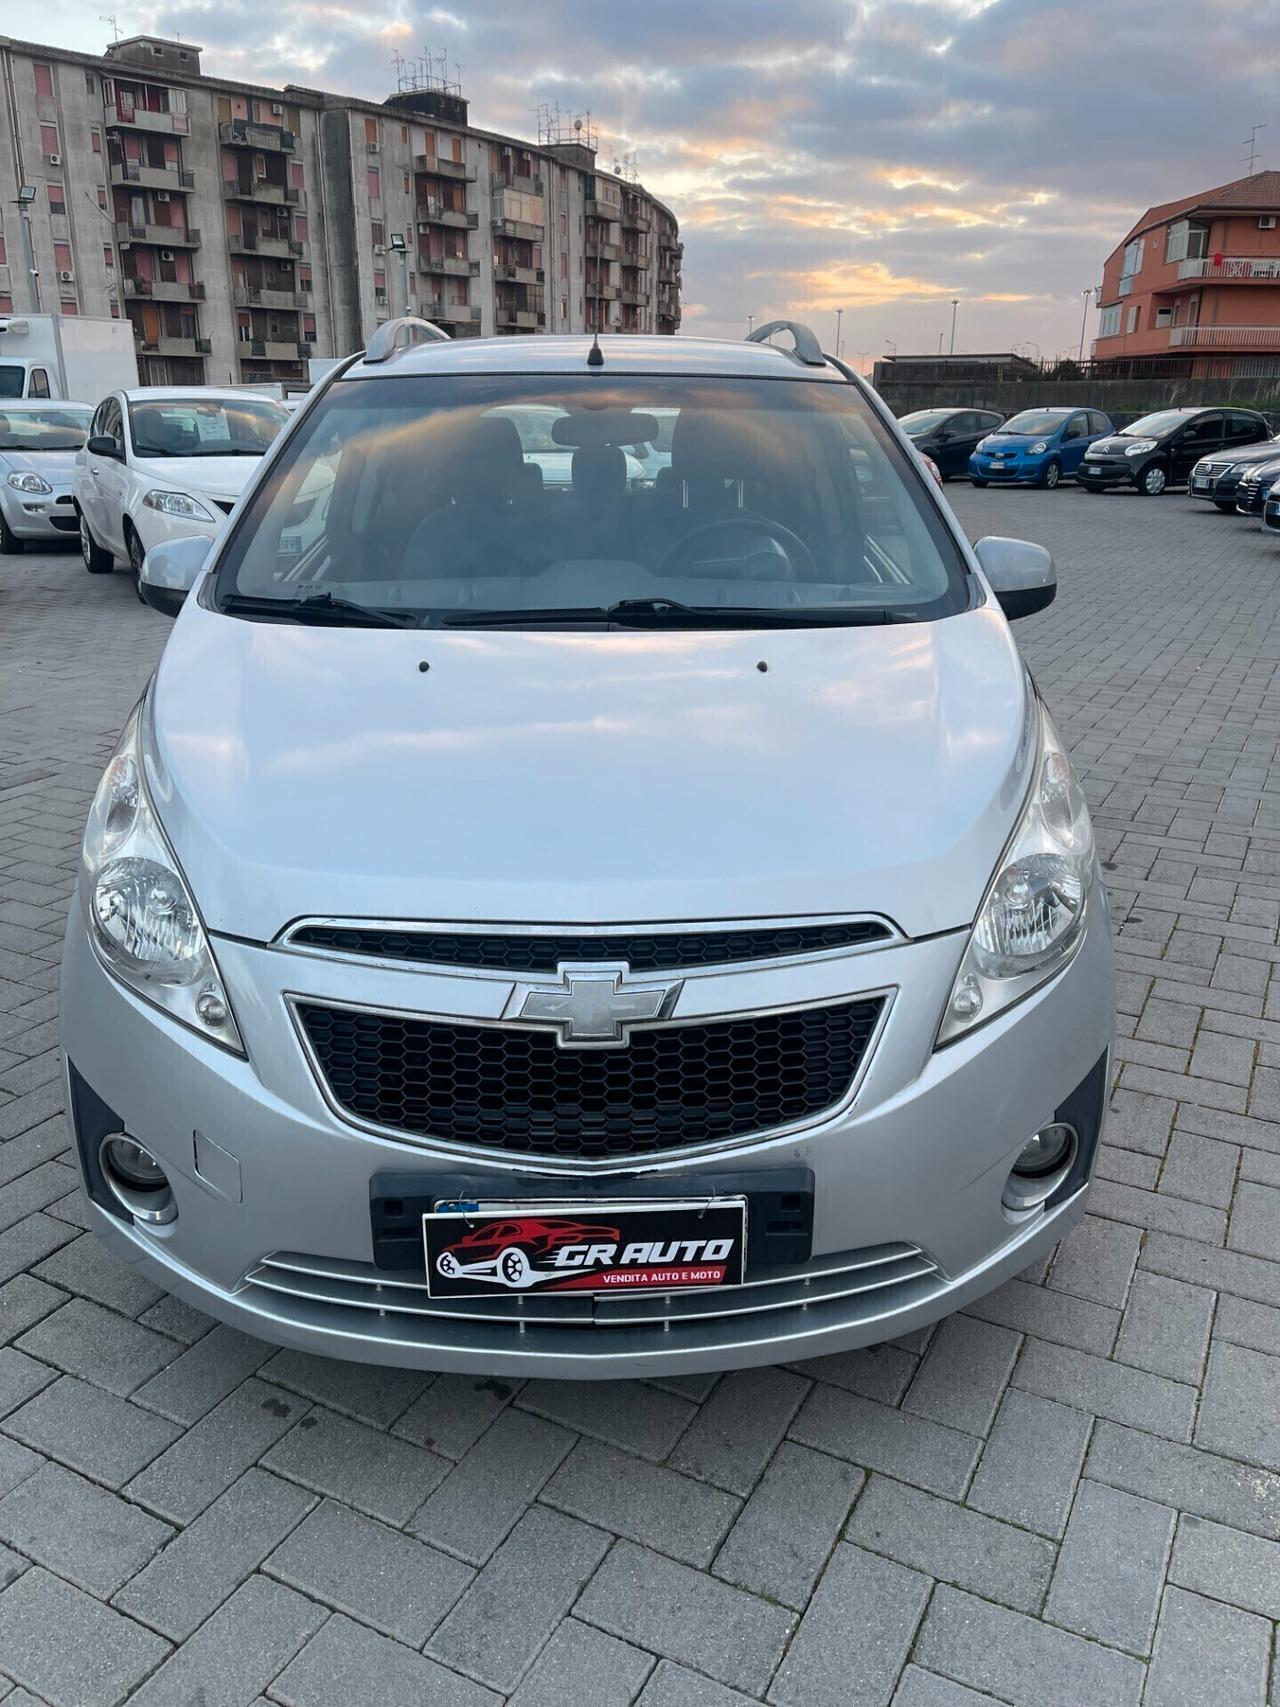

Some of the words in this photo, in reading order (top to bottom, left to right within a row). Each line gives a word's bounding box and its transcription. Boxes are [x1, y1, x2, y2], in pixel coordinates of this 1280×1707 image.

[555, 1244, 618, 1267] GR
[620, 1239, 735, 1264] AUTO
[603, 1274, 649, 1284] VENDITA
[651, 1272, 679, 1282] AUTO
[682, 1271, 688, 1280] E
[691, 1270, 721, 1280] MOTO
